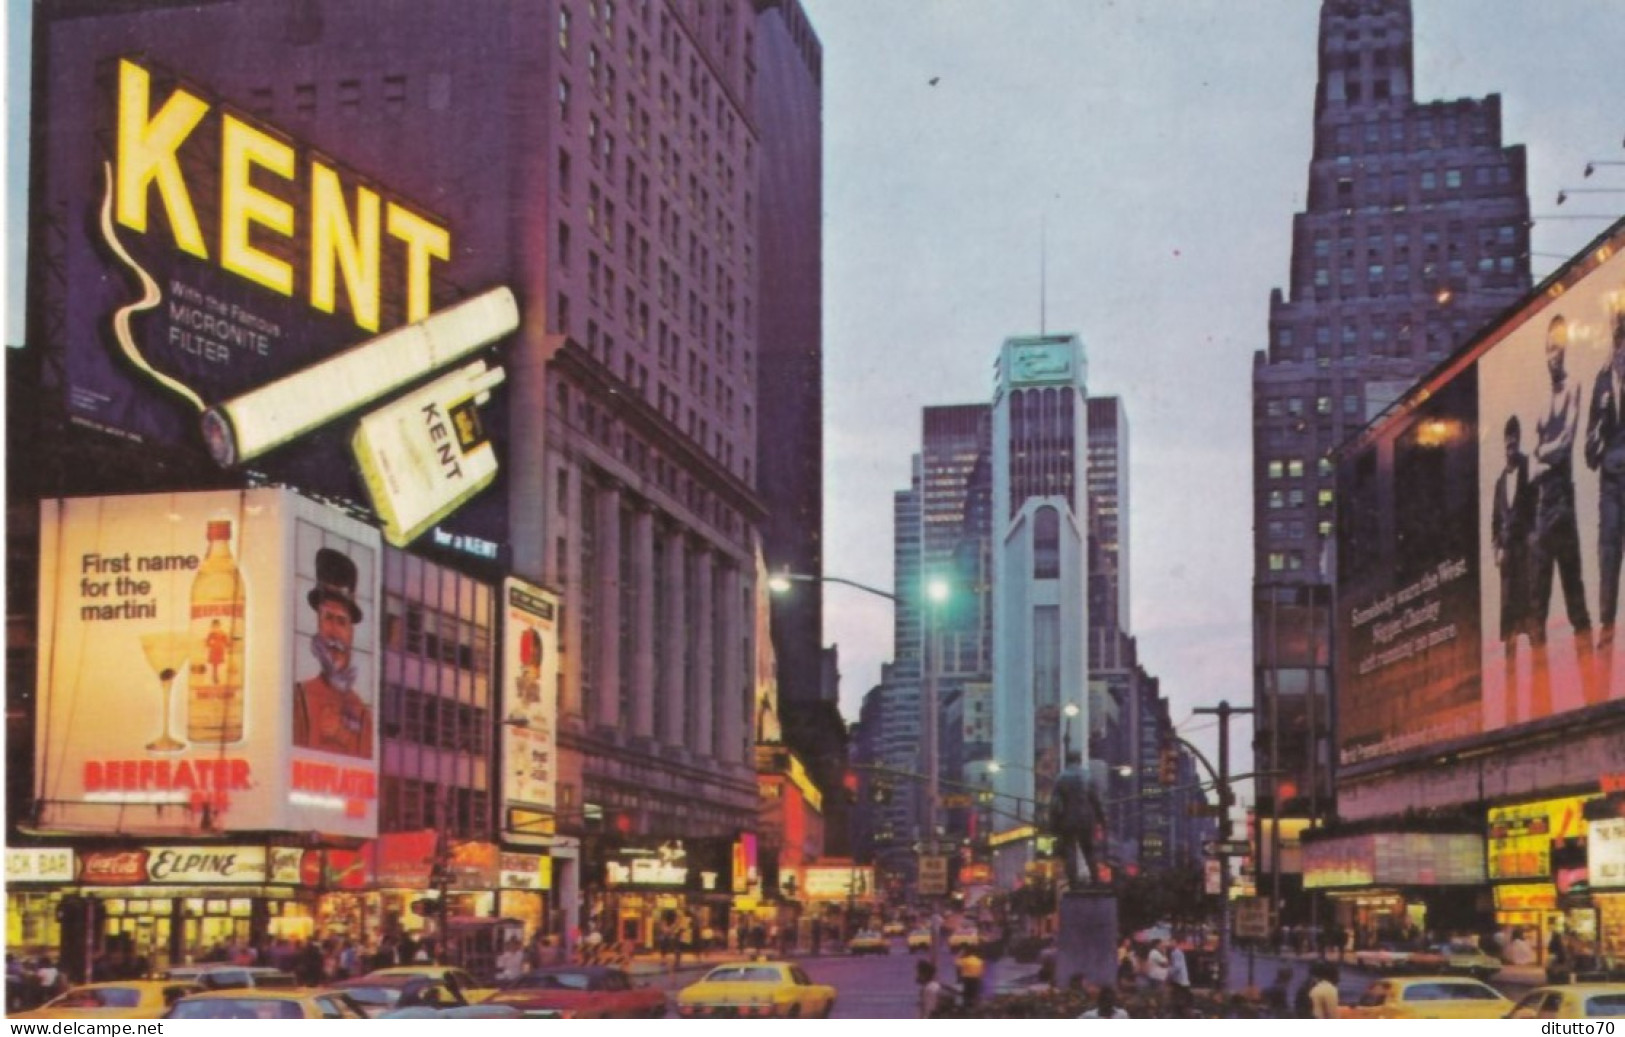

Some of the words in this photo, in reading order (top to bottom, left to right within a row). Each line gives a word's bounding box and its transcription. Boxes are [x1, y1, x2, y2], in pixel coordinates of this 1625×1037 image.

[116, 57, 451, 334] KENT
[169, 300, 269, 357] MICRONITE
[168, 326, 231, 363] FILTER
[421, 402, 463, 480] KENT
[82, 551, 131, 574] First
[137, 554, 200, 572] name
[80, 577, 109, 598] for
[115, 576, 152, 597] the
[81, 598, 157, 621] martini
[84, 760, 252, 791] BEEFEATER
[38, 853, 69, 875] BAR
[151, 850, 238, 879] ELPINE
